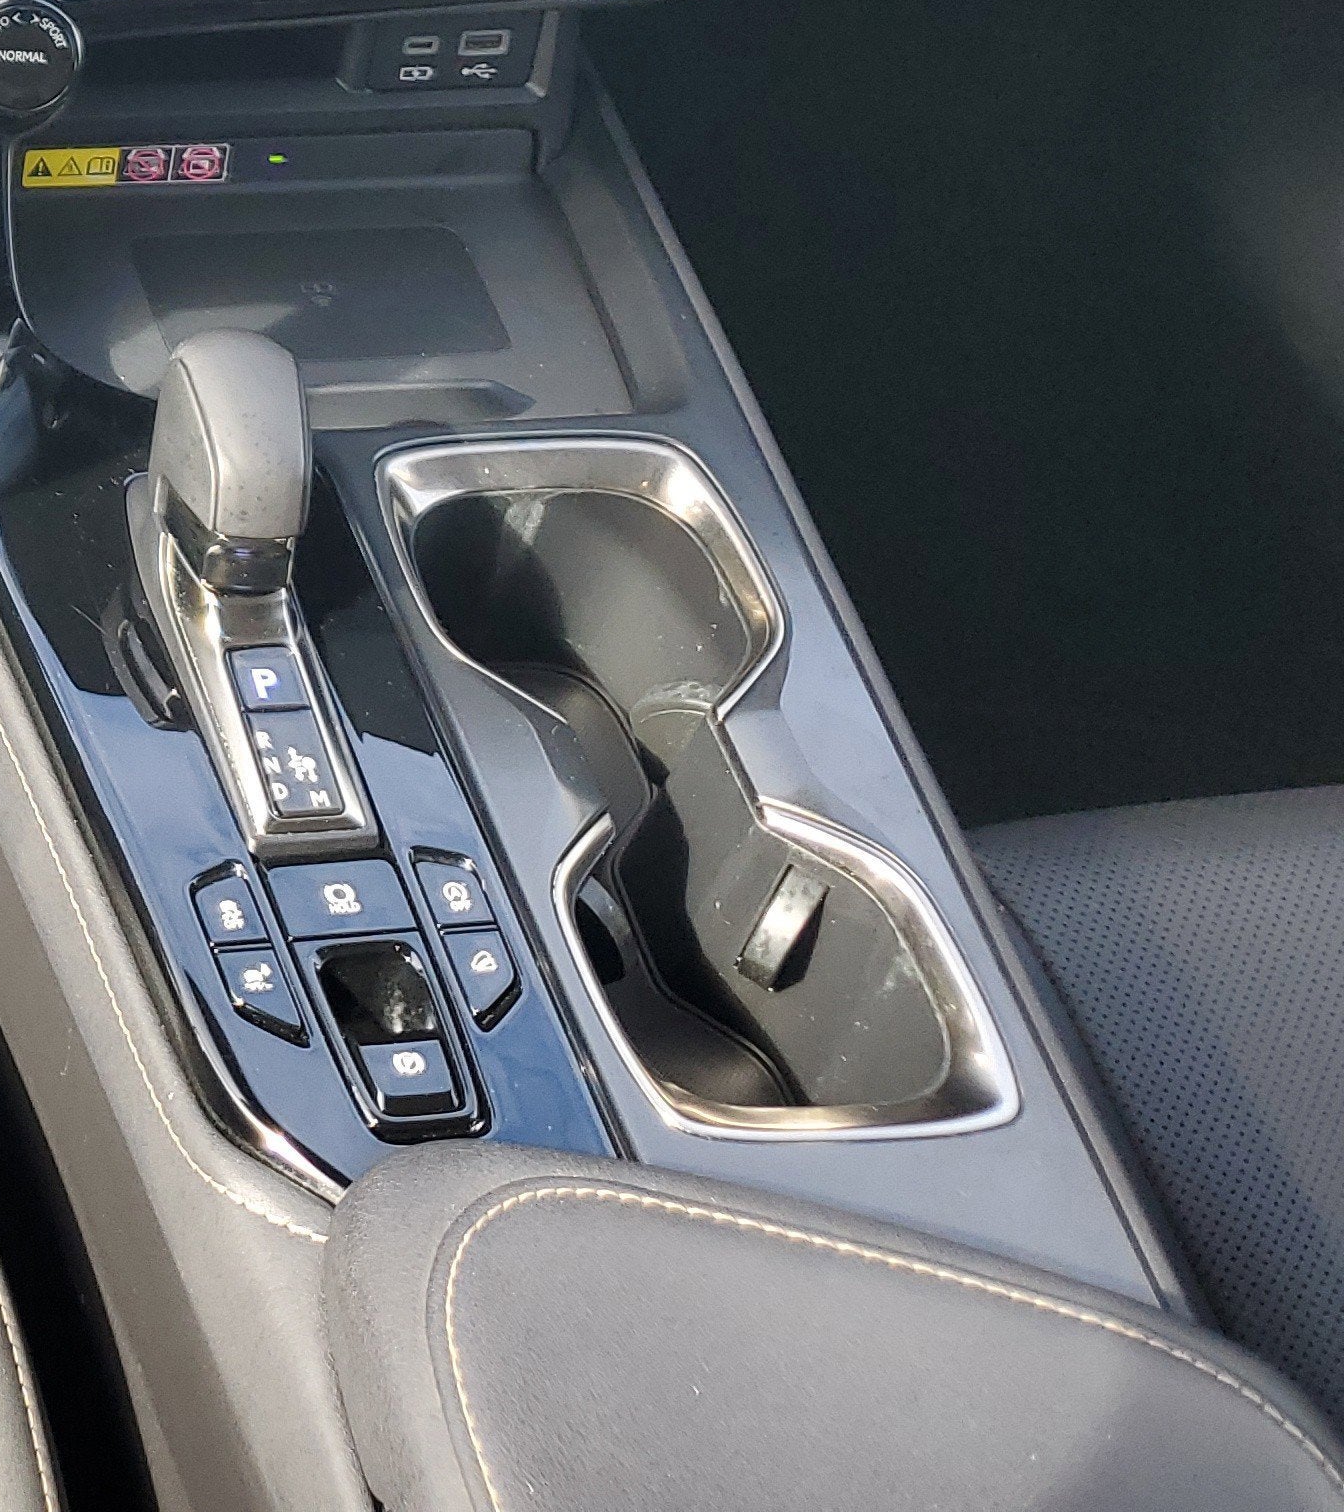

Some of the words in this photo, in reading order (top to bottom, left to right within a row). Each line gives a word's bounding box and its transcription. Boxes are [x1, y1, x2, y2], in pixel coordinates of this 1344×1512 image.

[39, 17, 67, 49] SPORT
[251, 668, 278, 699] P
[255, 731, 274, 749] R
[262, 756, 282, 775] N
[271, 782, 289, 800] D
[309, 790, 331, 808] M
[328, 900, 362, 916] HOLD
